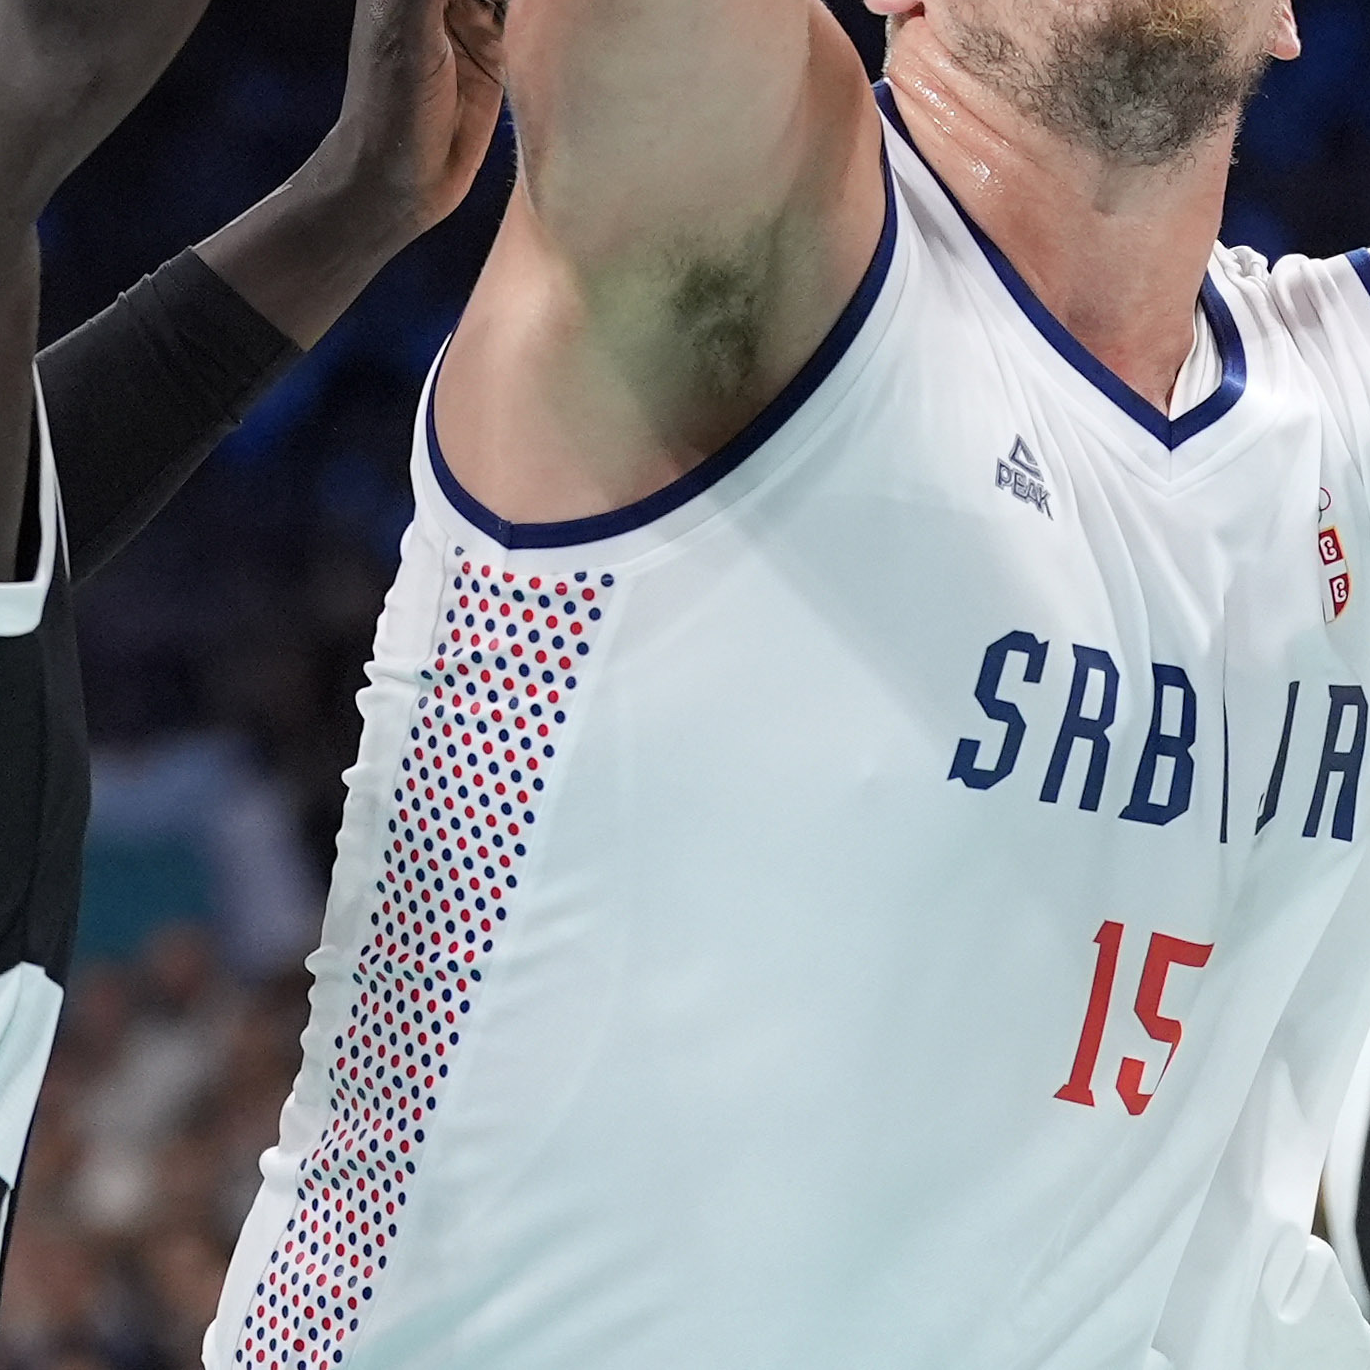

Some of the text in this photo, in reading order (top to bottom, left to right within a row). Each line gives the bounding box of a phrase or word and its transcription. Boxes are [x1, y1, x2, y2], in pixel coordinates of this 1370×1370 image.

[994, 457, 1054, 521] PEAK
[946, 629, 1370, 844] SRBJA
[1054, 921, 1215, 1116] 15
